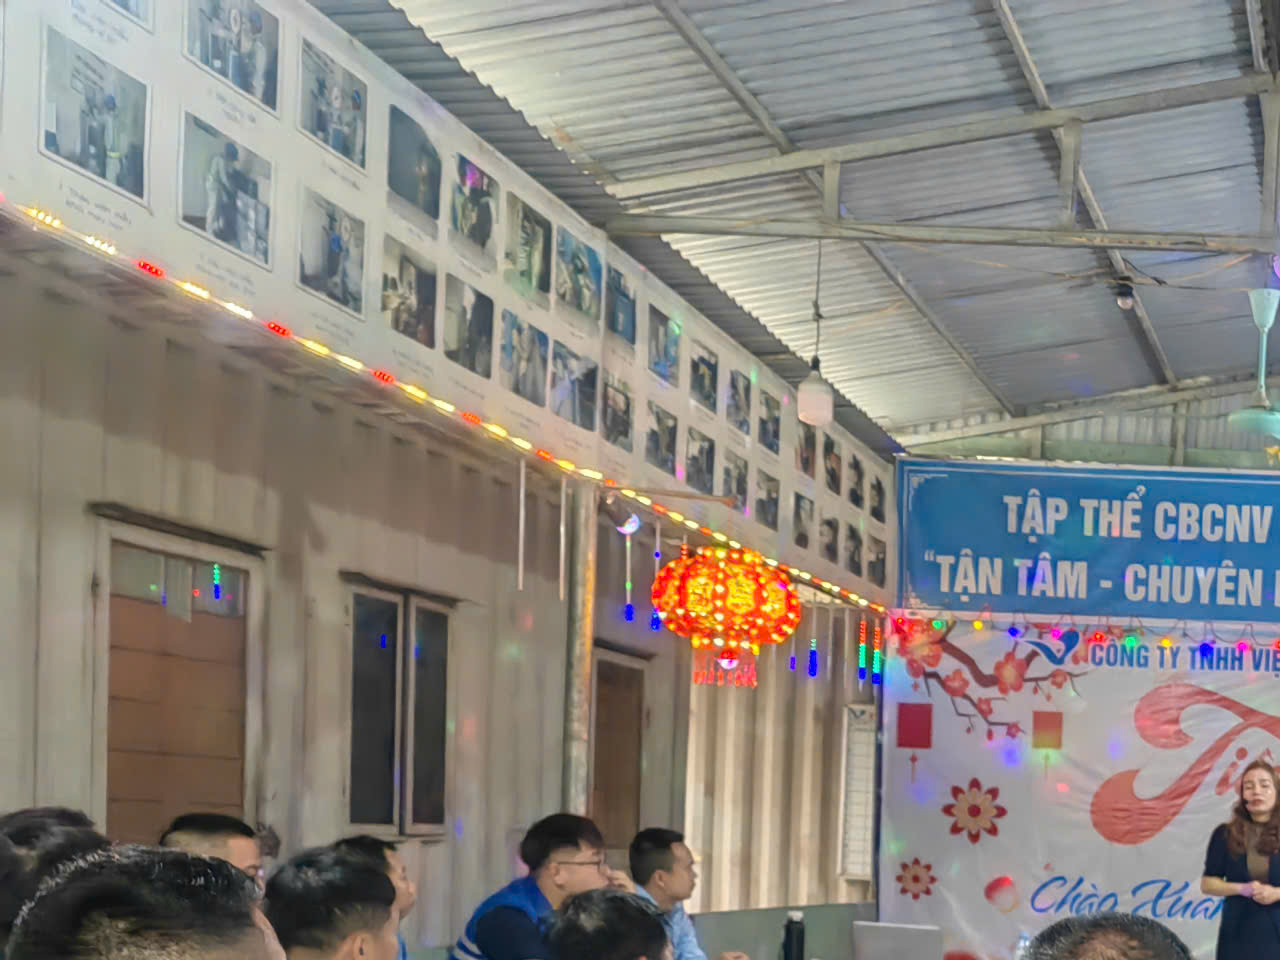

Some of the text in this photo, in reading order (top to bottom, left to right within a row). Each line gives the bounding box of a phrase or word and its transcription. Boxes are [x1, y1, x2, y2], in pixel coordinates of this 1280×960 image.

[1002, 488, 1068, 542] TẬP
[1079, 485, 1147, 538] THỂ
[1154, 502, 1273, 544] CBCNV
[1013, 551, 1088, 599] TÂM
[1100, 579, 1113, 589] -
[1124, 560, 1263, 607] CHUYÊN
[1090, 639, 1149, 668] CÔNG
[1157, 645, 1181, 669] TY
[1188, 646, 1244, 671] TNHH
[1030, 876, 1119, 915] Chào
